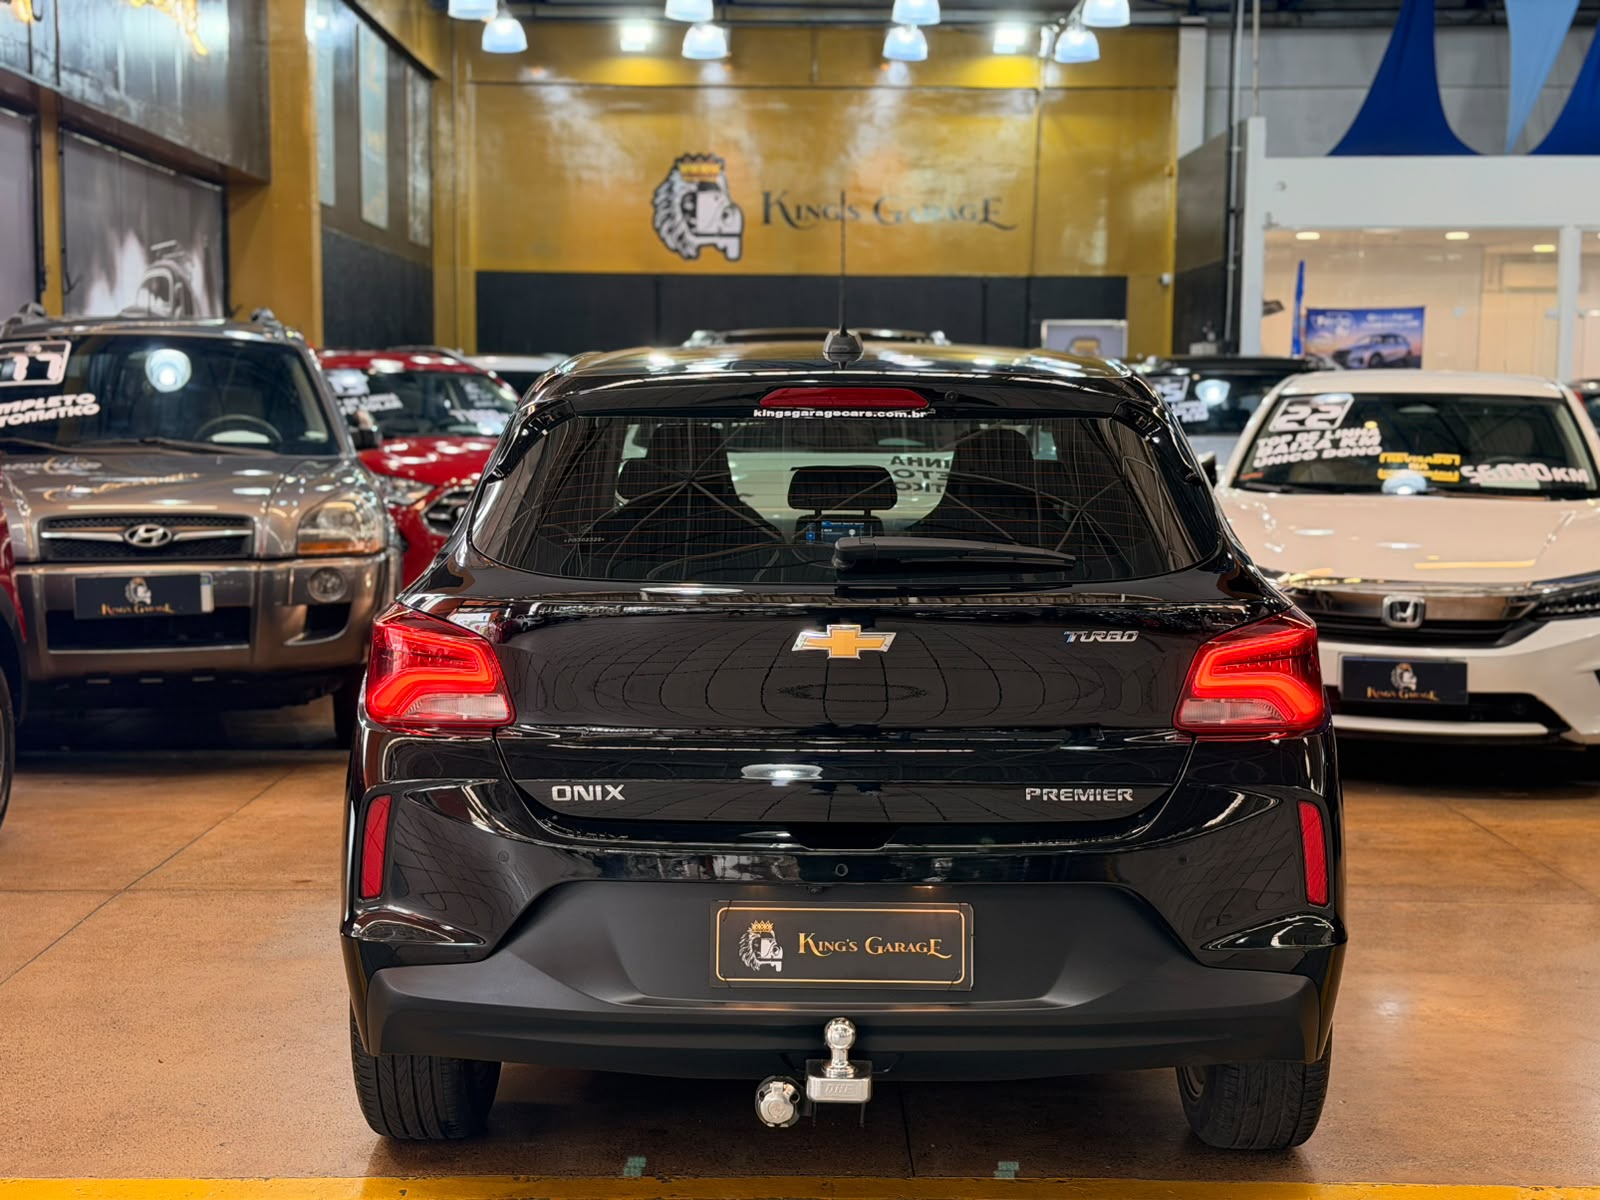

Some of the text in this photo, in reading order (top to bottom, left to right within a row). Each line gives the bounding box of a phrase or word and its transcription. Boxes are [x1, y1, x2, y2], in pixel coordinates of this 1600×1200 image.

[753, 408, 927, 418] kingsgaragecars.com.br
[1064, 630, 1138, 643] TURBO
[551, 784, 625, 801] ONIX
[1025, 787, 1133, 801] PREMIER
[865, 936, 952, 959] GARAGE
